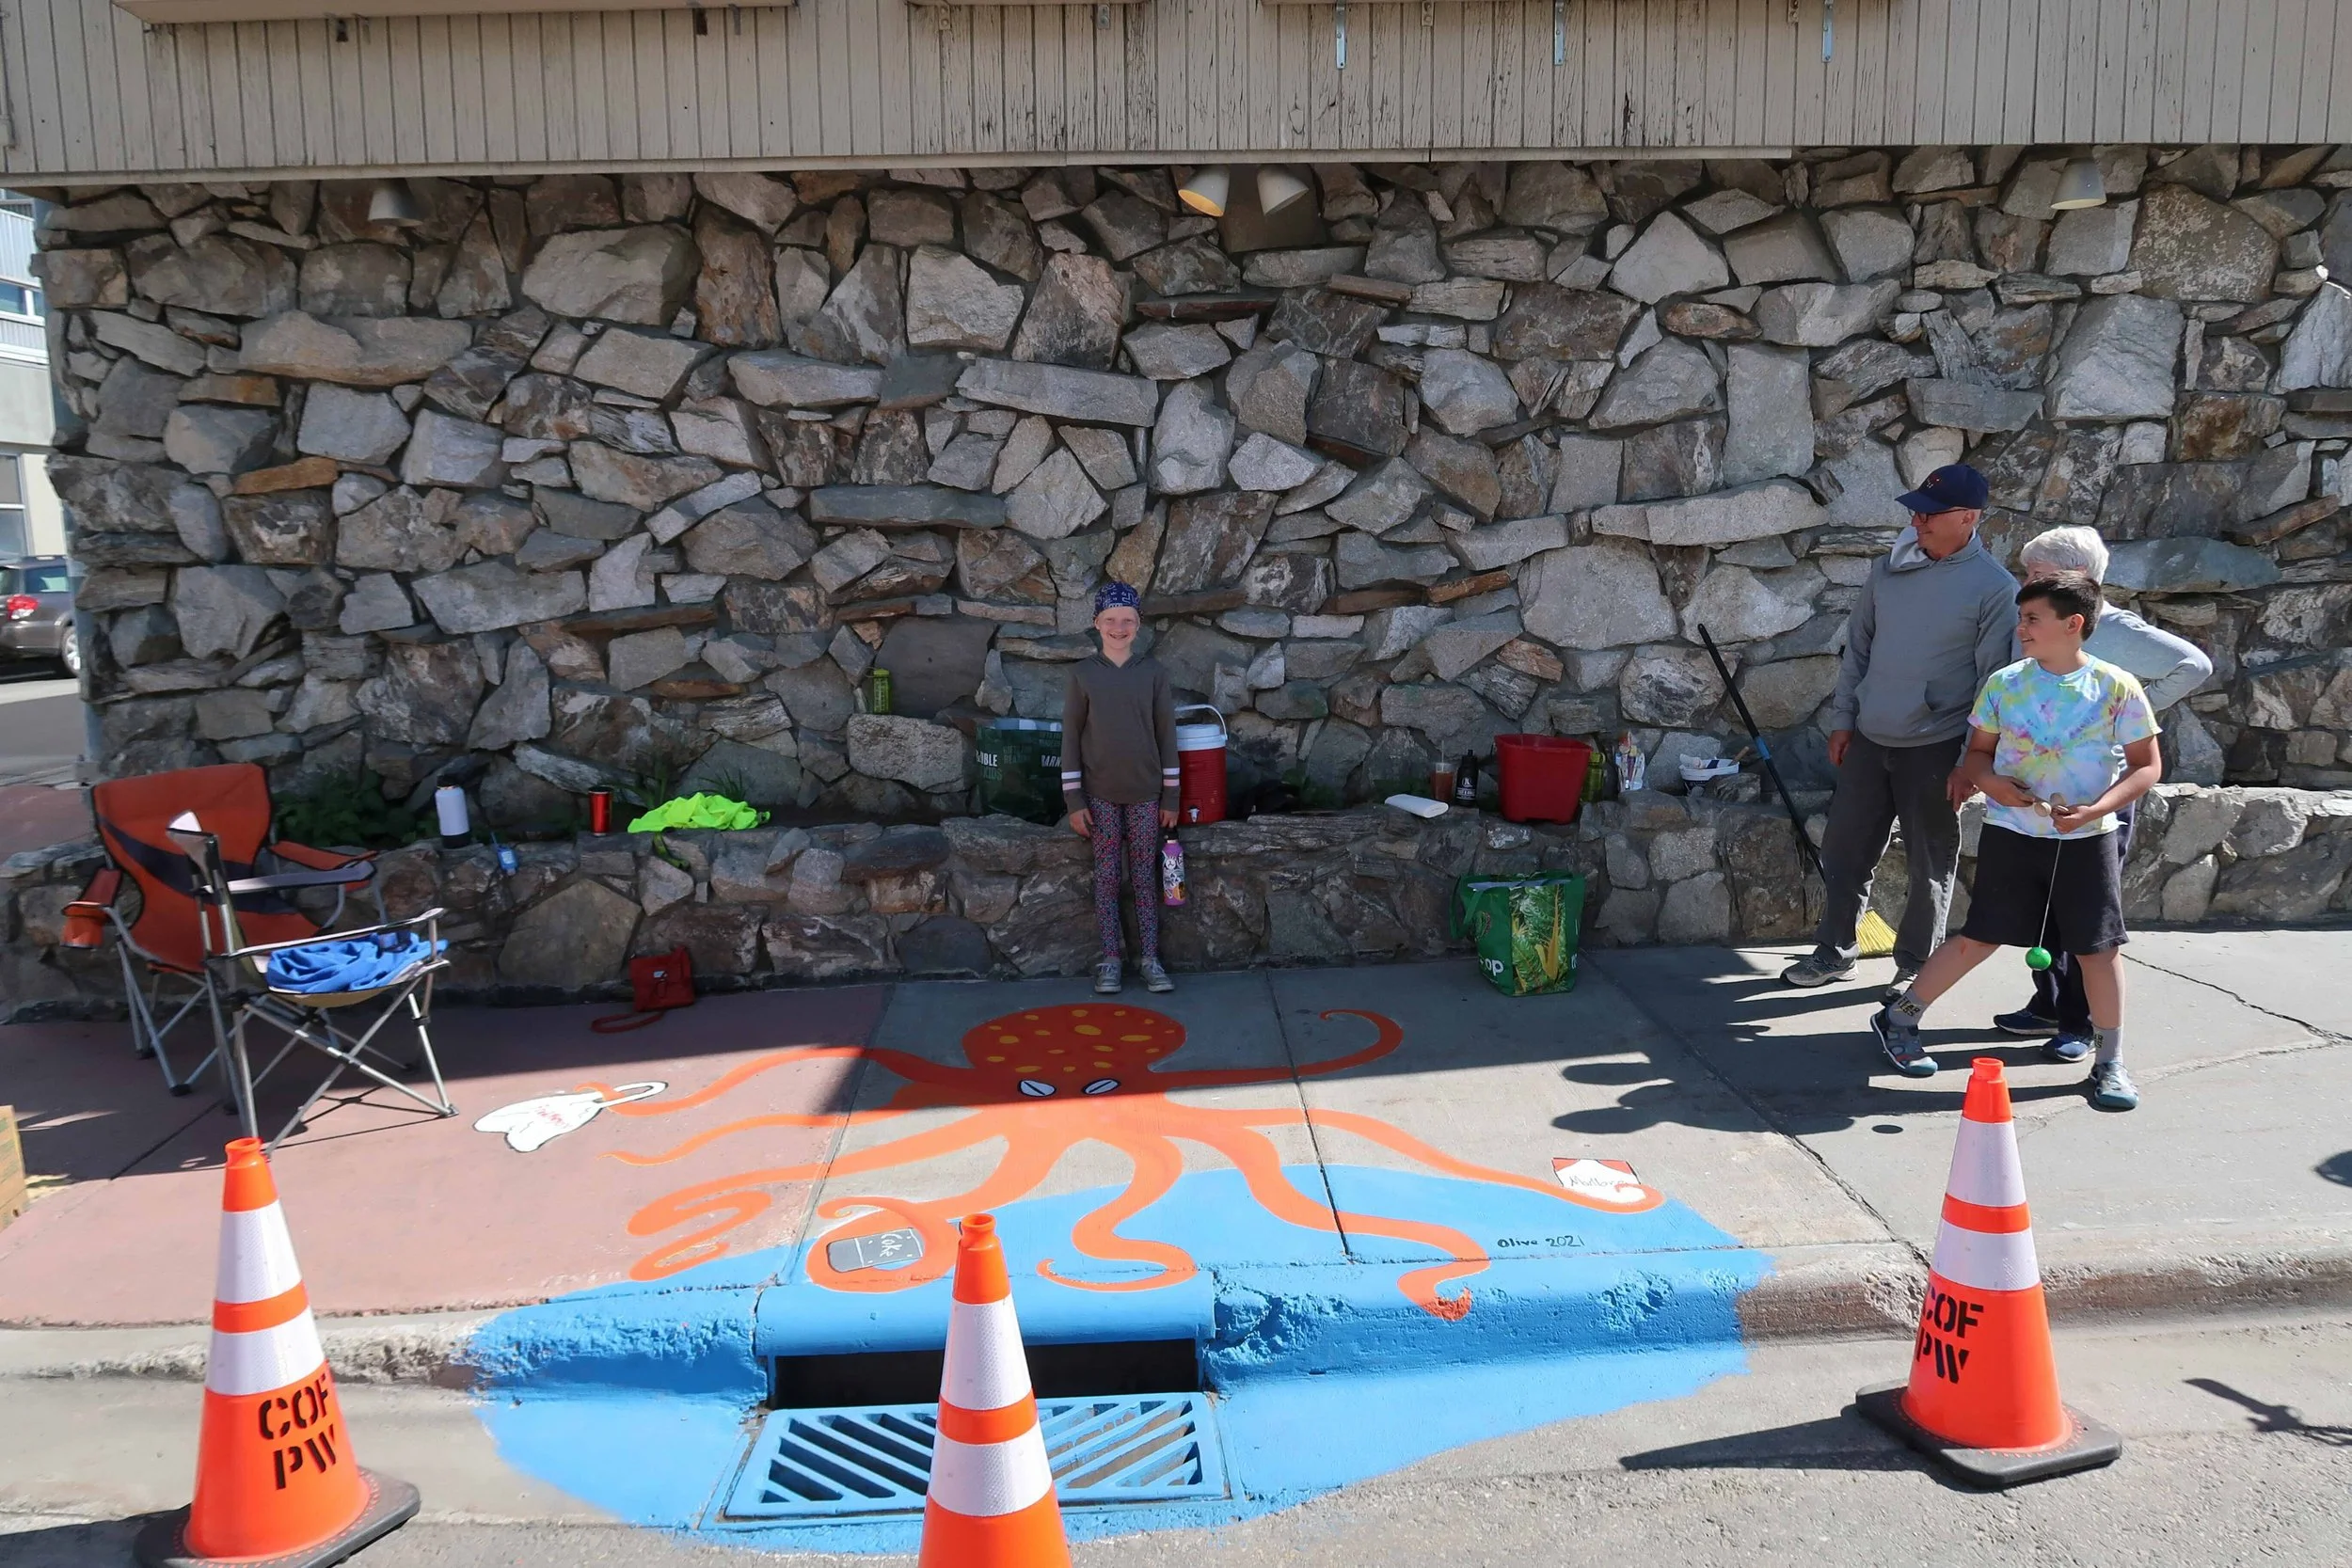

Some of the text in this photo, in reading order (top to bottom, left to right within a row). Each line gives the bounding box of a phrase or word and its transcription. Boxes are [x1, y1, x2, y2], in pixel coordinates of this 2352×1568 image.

[1497, 1235, 1585, 1248] Olive 2021
[1916, 1326, 1969, 1384] PW
[259, 1373, 328, 1440] COF
[273, 1423, 337, 1491] PW
